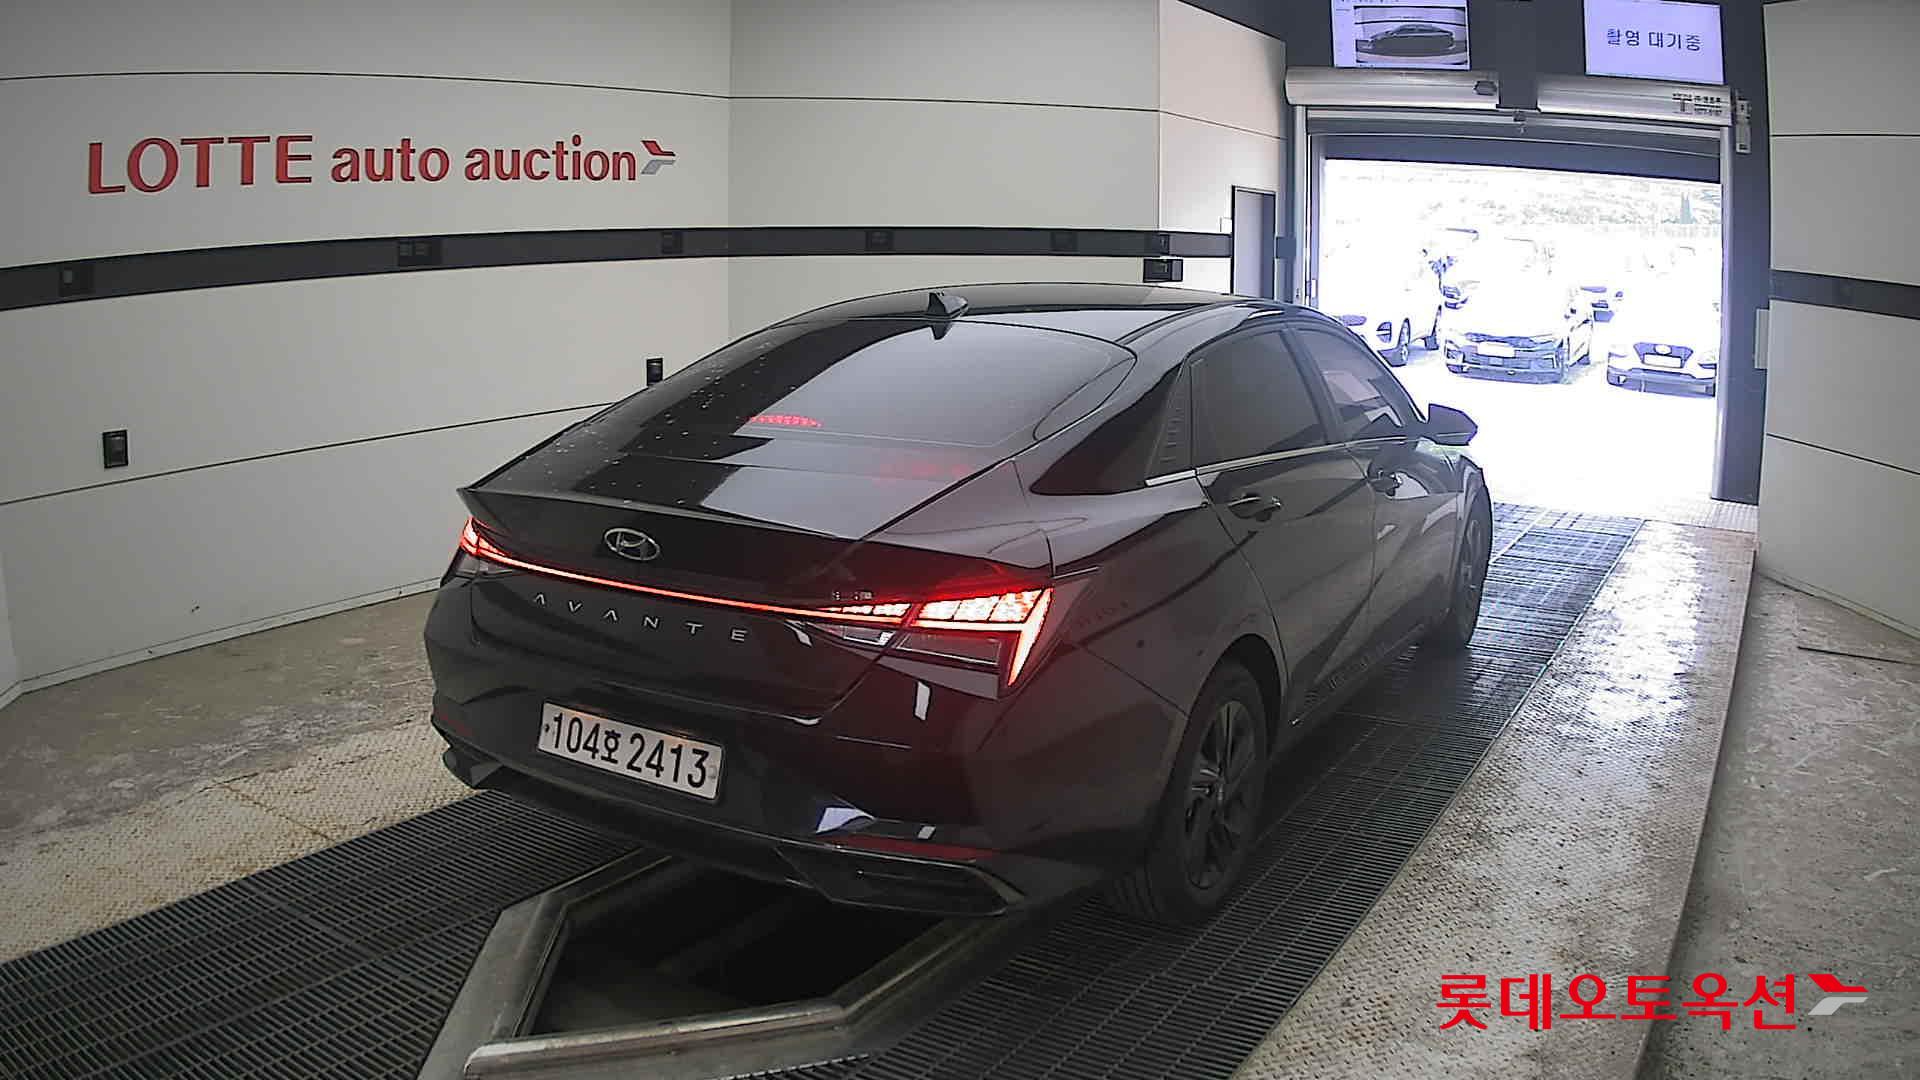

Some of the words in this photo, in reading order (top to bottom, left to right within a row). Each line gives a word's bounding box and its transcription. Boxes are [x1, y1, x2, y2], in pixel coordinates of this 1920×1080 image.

[1607, 28, 1640, 46] 촬영
[1648, 31, 1701, 51] 대기중
[88, 135, 313, 194] LOTTE
[331, 138, 450, 182] auto
[464, 135, 637, 182] auction
[534, 593, 748, 641] AVANTE
